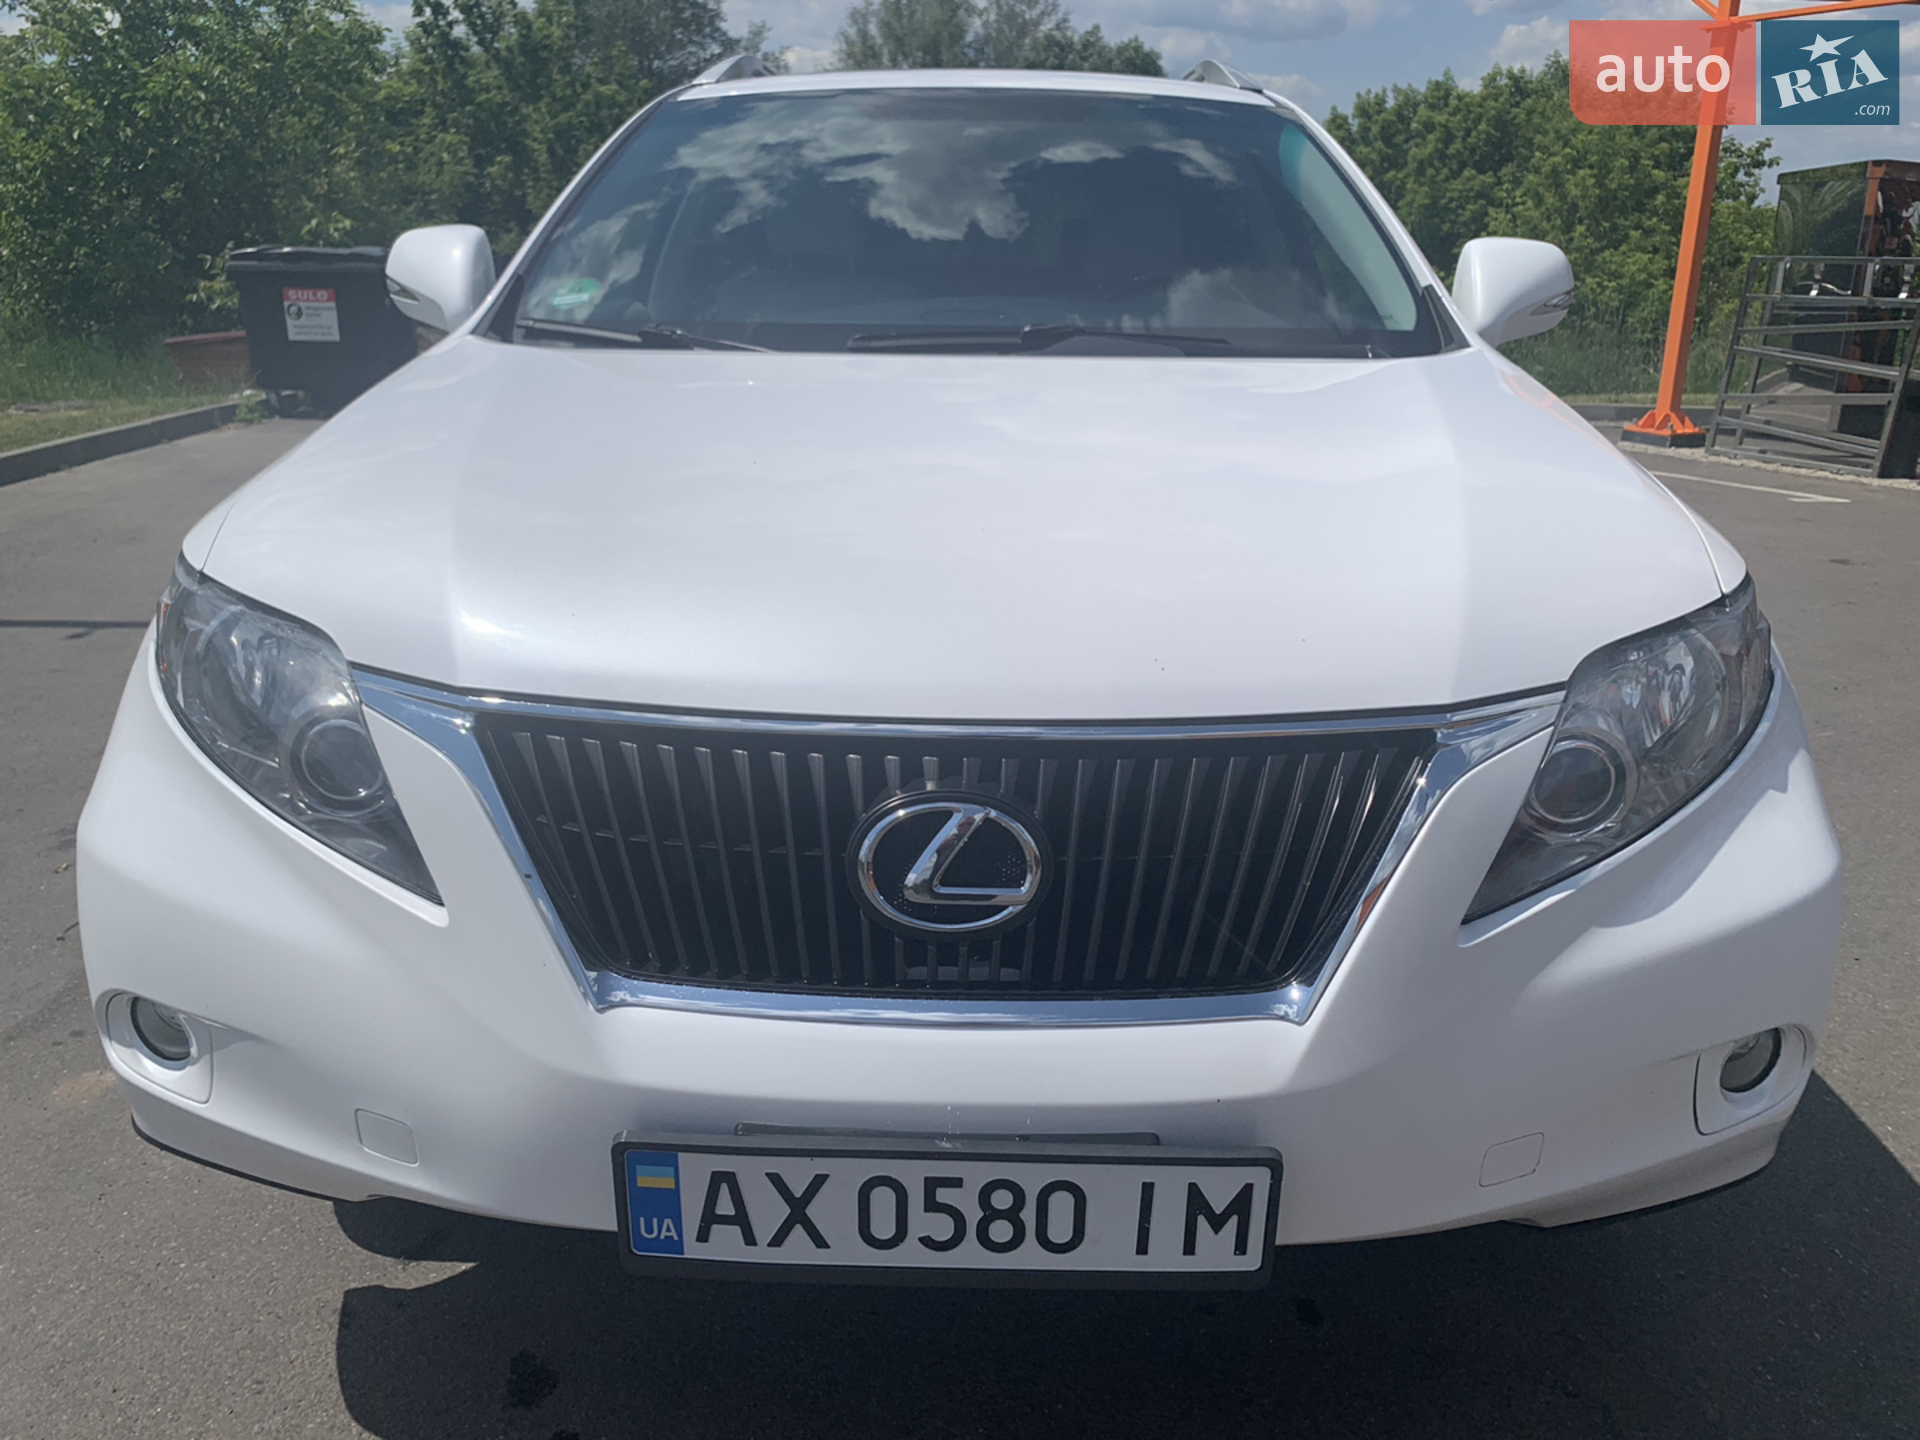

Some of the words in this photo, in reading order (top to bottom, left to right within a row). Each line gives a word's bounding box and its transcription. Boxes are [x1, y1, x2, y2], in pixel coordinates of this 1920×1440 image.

[288, 290, 328, 301] SULO
[695, 1170, 831, 1249] AX
[857, 1174, 1087, 1254] 0580
[1134, 1181, 1254, 1256] IM
[640, 1217, 679, 1241] UA
